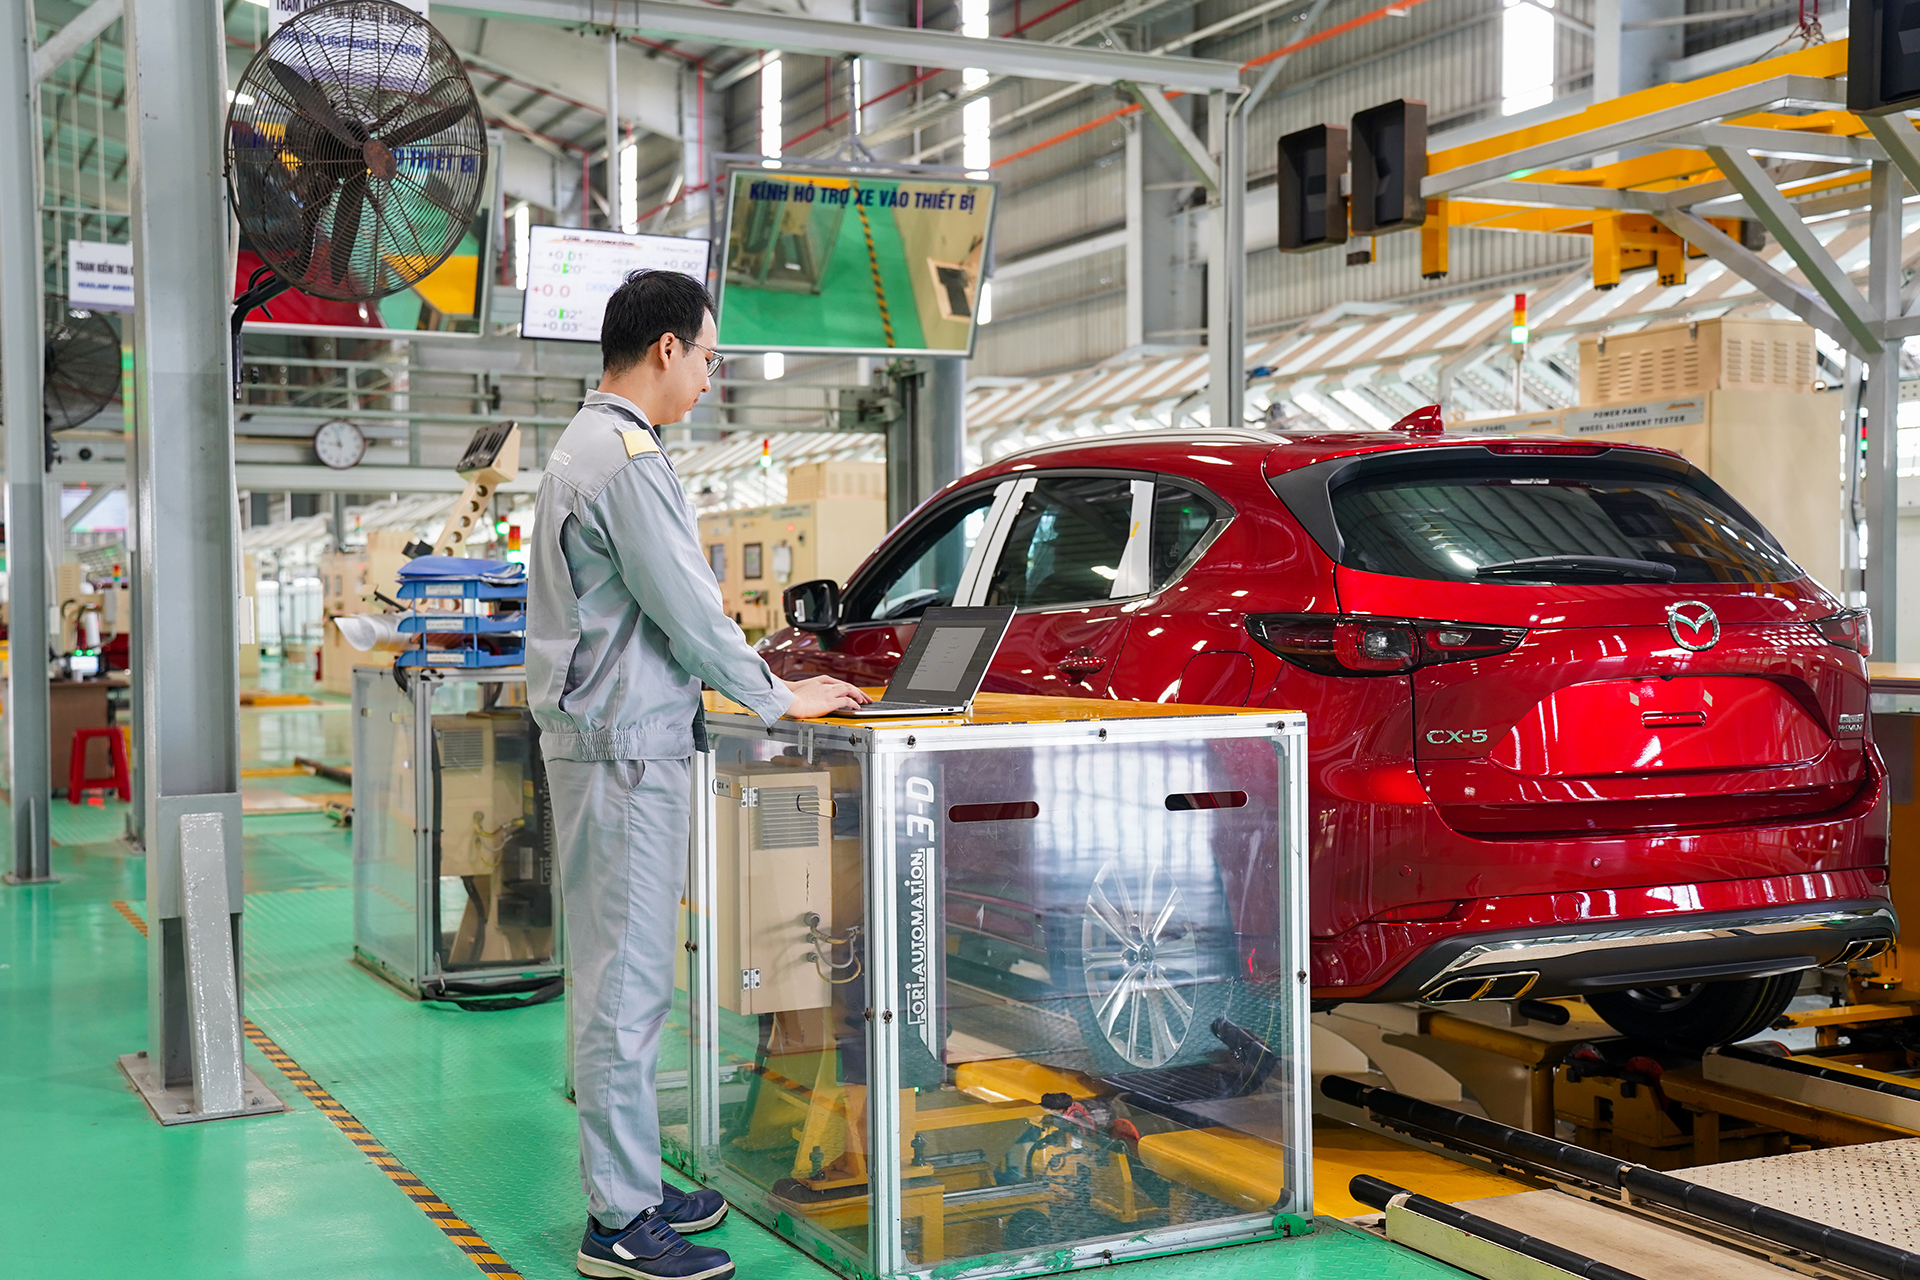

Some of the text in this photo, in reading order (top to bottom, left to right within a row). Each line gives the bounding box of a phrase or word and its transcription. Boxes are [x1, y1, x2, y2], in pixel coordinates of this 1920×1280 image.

[750, 181, 788, 201] KÍNH
[821, 187, 850, 209] TRỢ
[854, 188, 875, 206] XE
[879, 187, 909, 208] VÀO
[915, 188, 955, 210] THIẾT
[960, 194, 975, 215] BỊ
[1579, 415, 1685, 433] WHEEL ALIGNMENT TESTER
[1593, 406, 1648, 419] POWER PANEL
[1426, 729, 1488, 744] CX-5
[906, 775, 935, 843] 3-D
[904, 849, 926, 977] AUTOMATION
